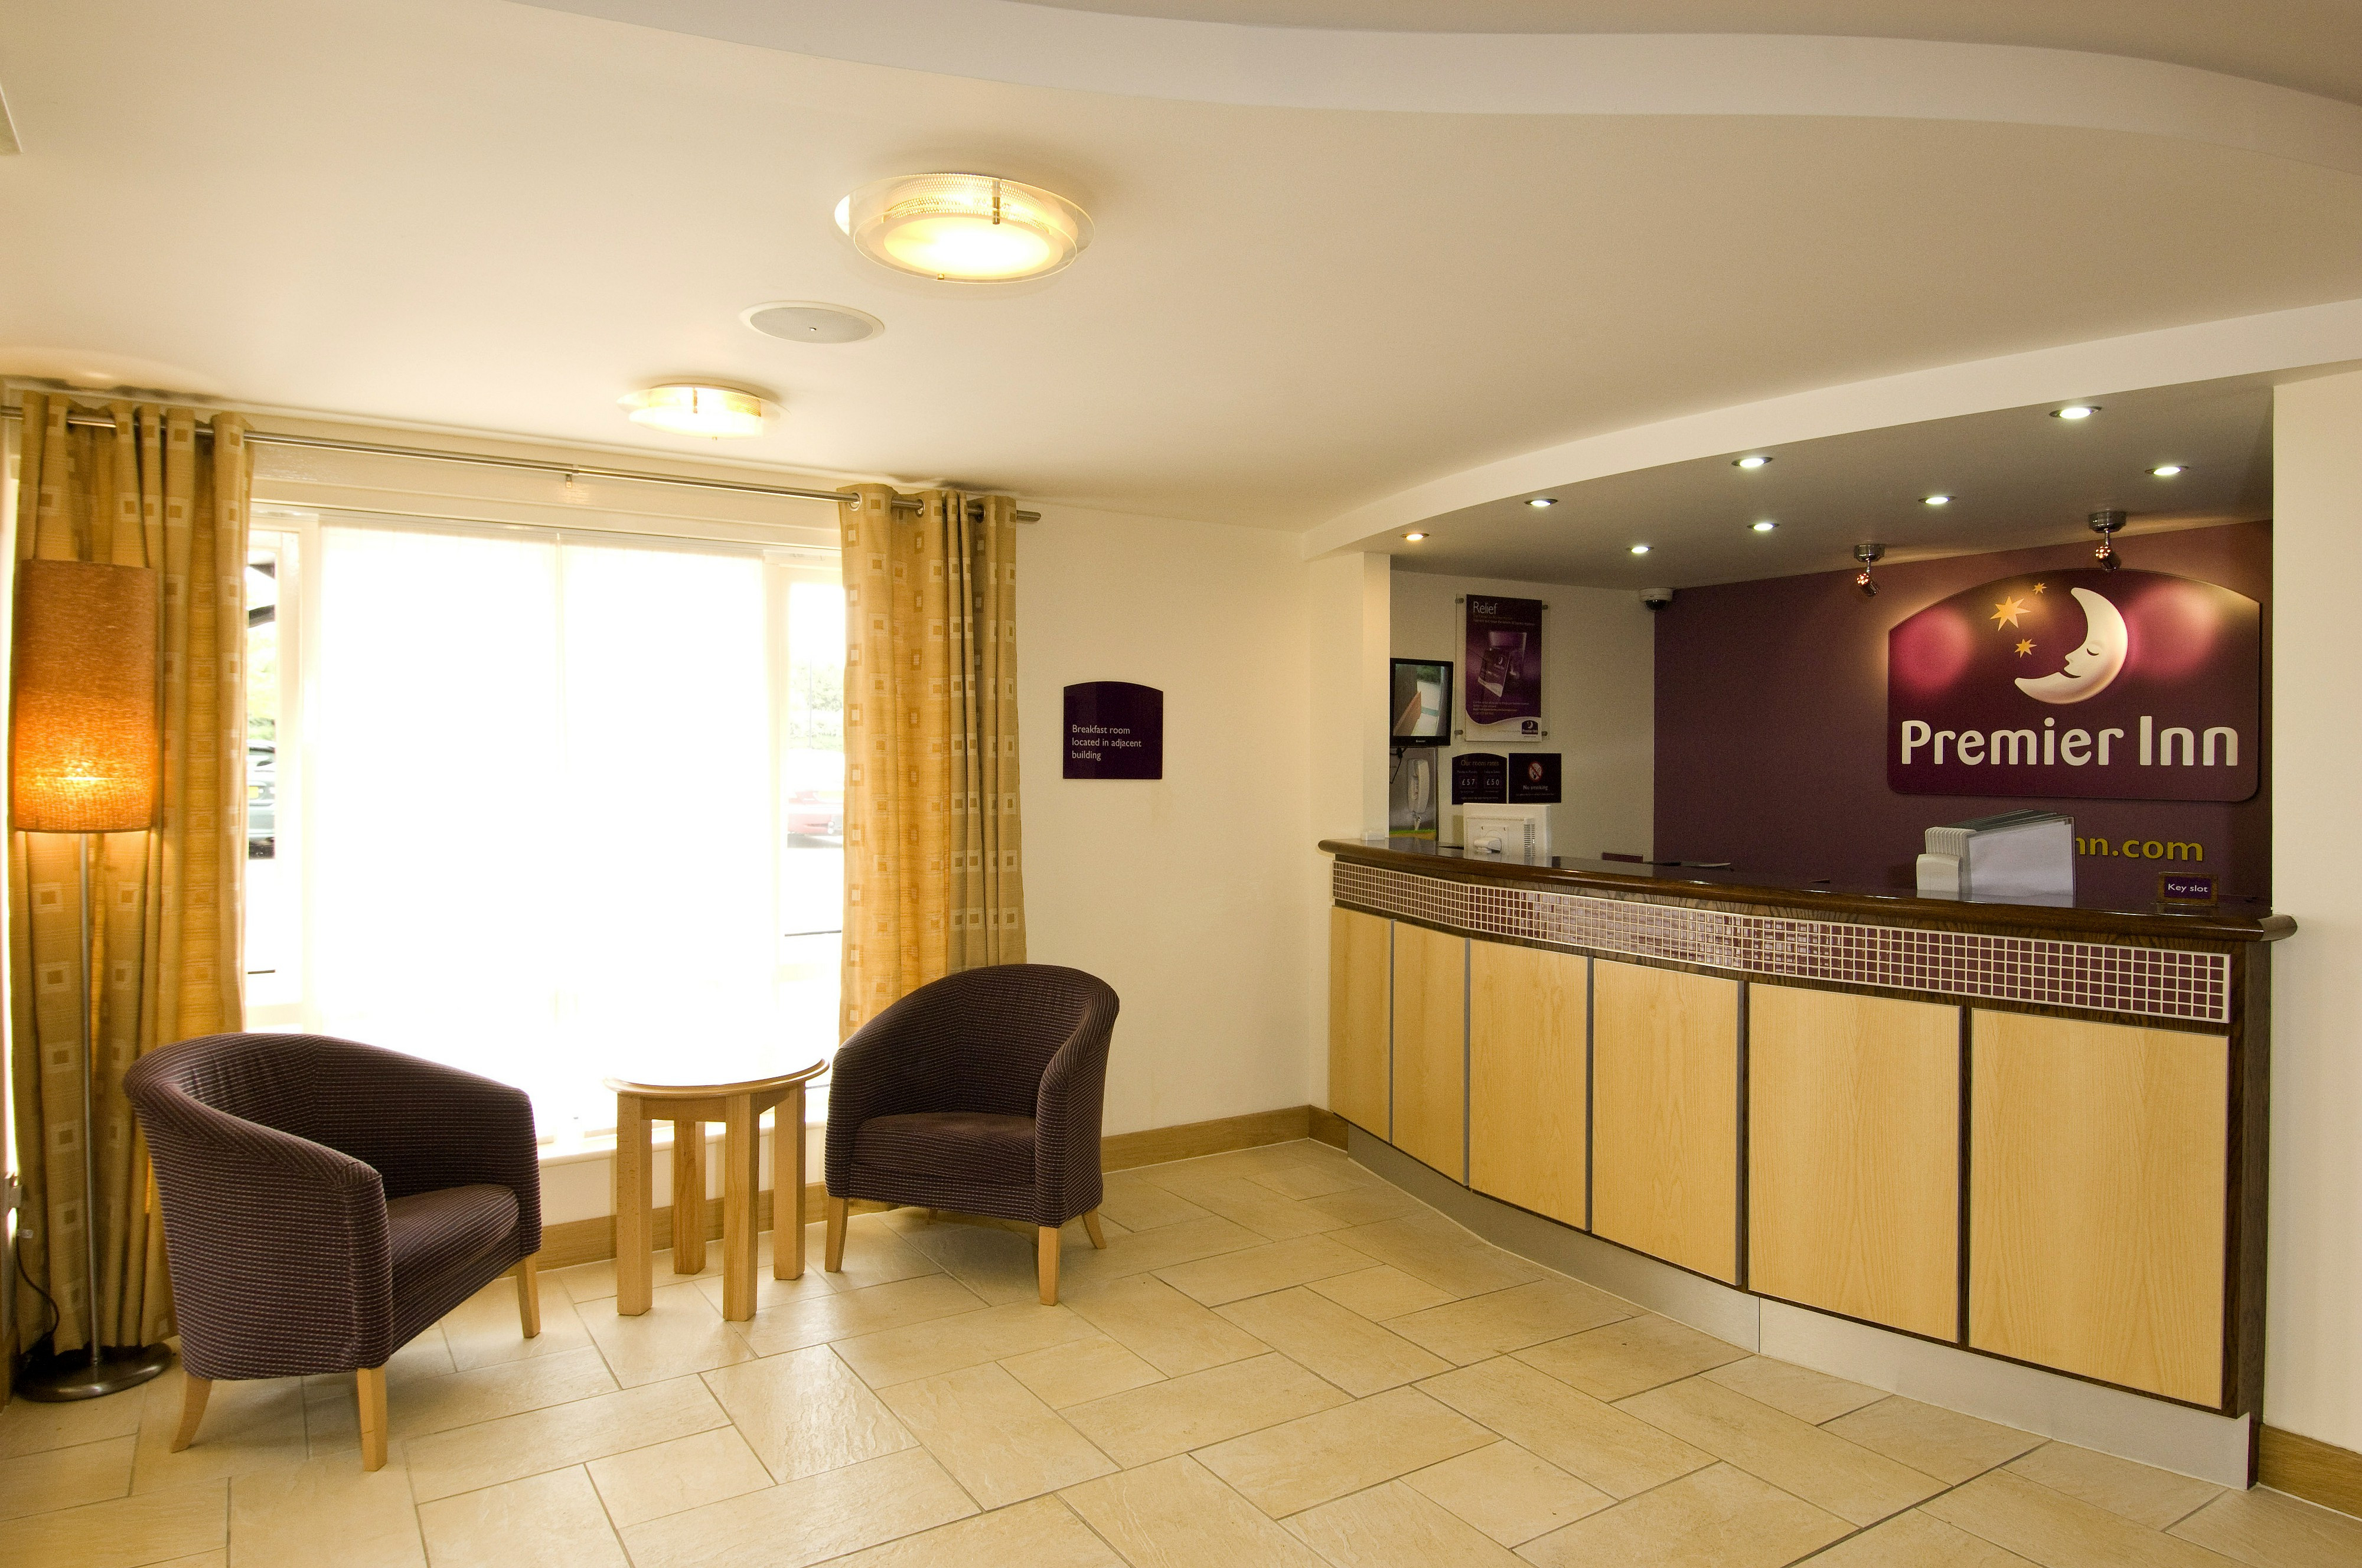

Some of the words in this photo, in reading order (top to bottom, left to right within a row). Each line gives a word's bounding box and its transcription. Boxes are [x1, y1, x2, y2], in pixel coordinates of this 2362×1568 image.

[1473, 601, 1498, 615] Relief
[1072, 724, 1108, 734] Breakfast
[1072, 737, 1100, 746] located
[1102, 739, 1109, 747] in
[1111, 739, 1142, 749] adjacent
[1901, 717, 2124, 766] Premier
[2139, 716, 2238, 766] Inn
[1072, 750, 1101, 761] building
[2168, 883, 2187, 893] Key
[2190, 884, 2208, 893] slot
